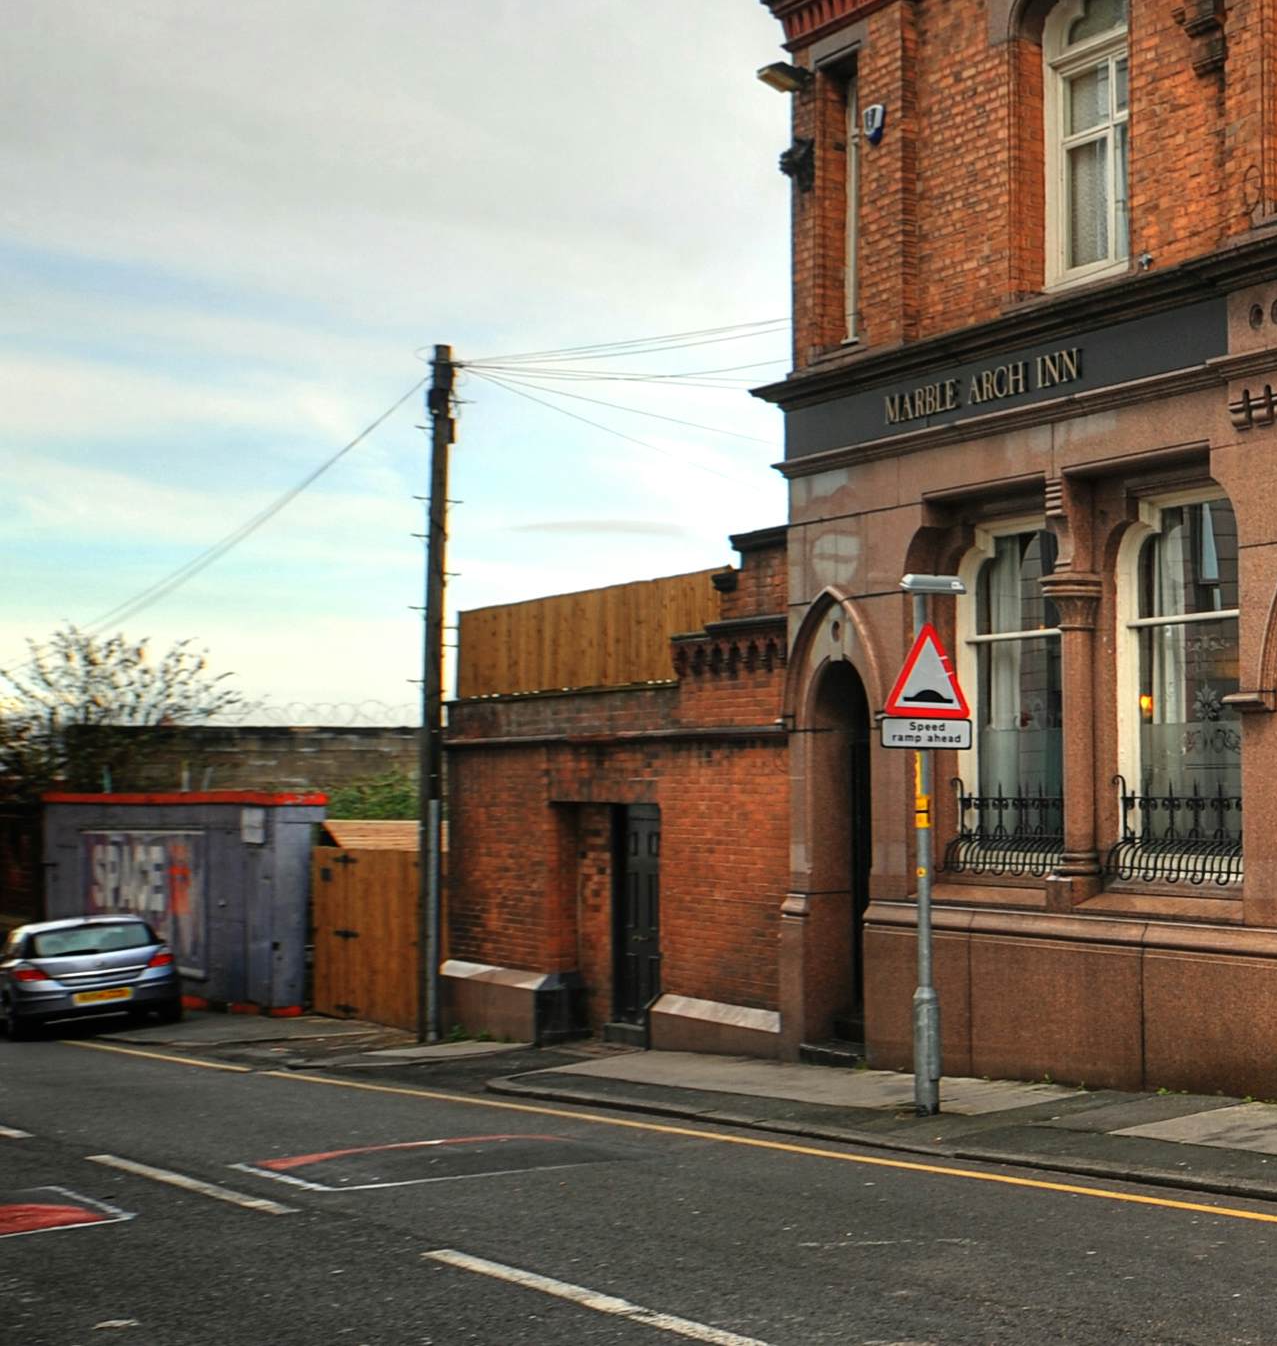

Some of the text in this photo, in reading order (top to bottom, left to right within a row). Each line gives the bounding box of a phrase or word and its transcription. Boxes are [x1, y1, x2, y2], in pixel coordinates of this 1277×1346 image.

[884, 347, 1079, 424] MARBLE ARCH INN
[909, 722, 945, 735] Speed
[892, 733, 961, 744] ramp ahead
